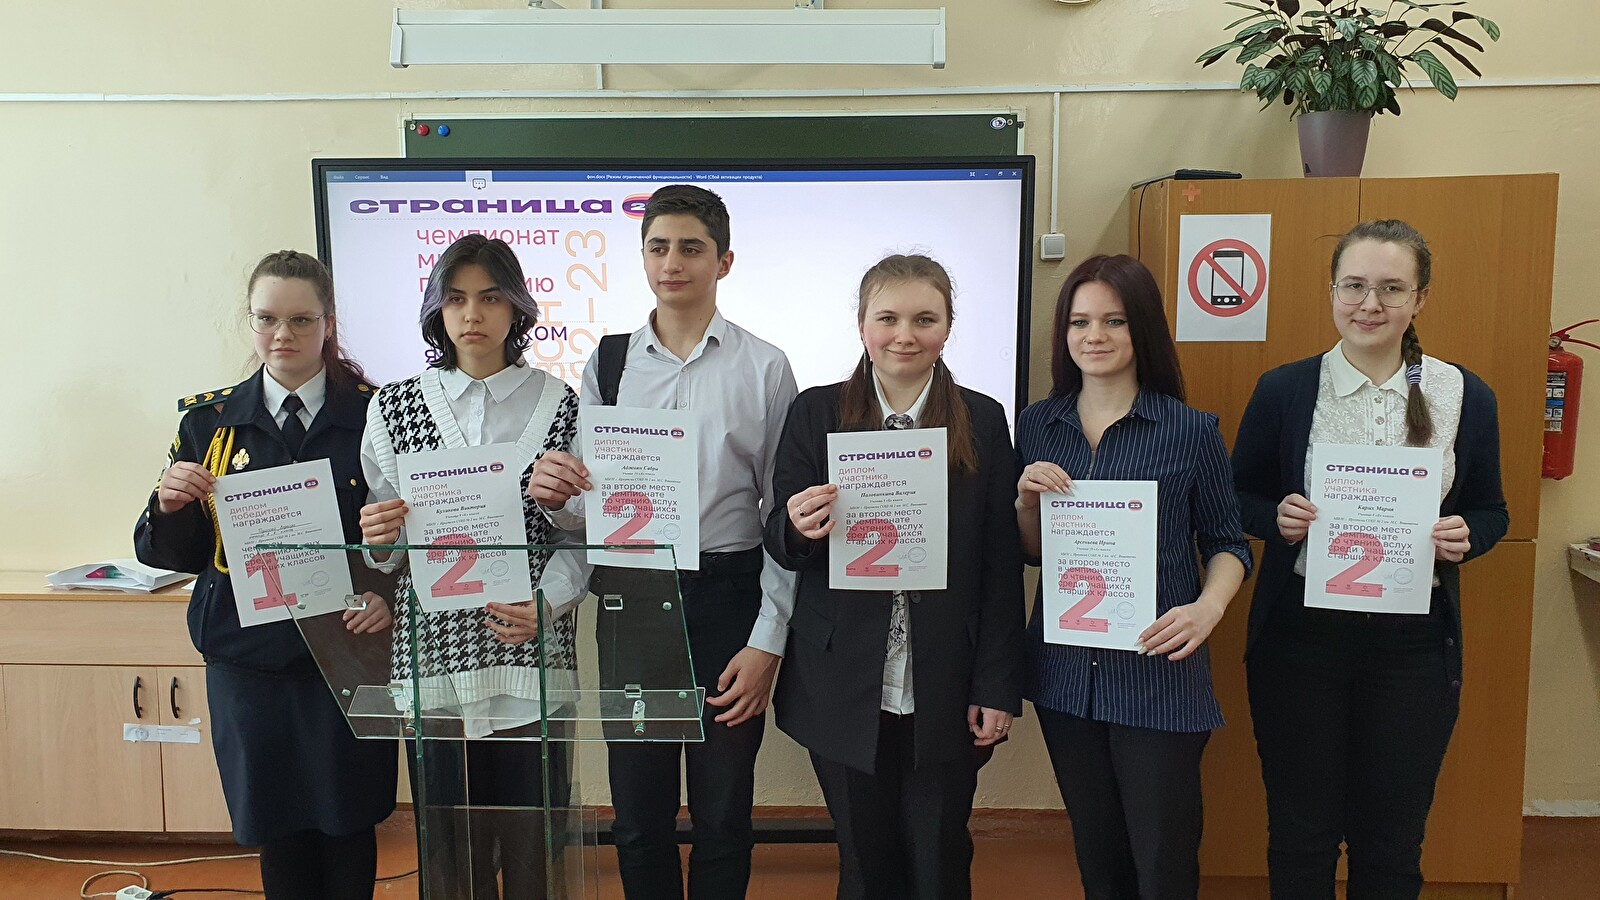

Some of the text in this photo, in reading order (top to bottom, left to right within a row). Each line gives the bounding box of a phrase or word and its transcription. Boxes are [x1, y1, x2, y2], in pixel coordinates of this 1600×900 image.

[350, 199, 612, 214] страница
[416, 229, 560, 246] чемионат
[594, 426, 668, 436] страница
[595, 453, 661, 462] награждается
[838, 450, 916, 462] страница
[410, 466, 488, 481] страница
[839, 467, 875, 475] диплом
[1326, 464, 1409, 476] страница
[839, 474, 888, 483] участника
[410, 483, 448, 494] диплом
[839, 480, 906, 490] награждается
[1325, 485, 1377, 494] участника
[224, 482, 302, 502] страница
[412, 488, 462, 501] участника
[1324, 493, 1397, 502] награждается
[413, 493, 481, 508] награждается
[1051, 501, 1125, 509] страница
[230, 502, 267, 516] диплом
[231, 506, 289, 522] победителя
[232, 510, 302, 528] награждается
[603, 491, 655, 554] 2
[436, 525, 469, 534] второе
[472, 521, 499, 530] место
[897, 524, 923, 532] вслух
[1051, 528, 1115, 537] награждается
[1343, 524, 1378, 532] второе
[432, 530, 488, 541] чемпионате
[877, 531, 922, 539] учащихся
[1337, 532, 1398, 540] чемпионате
[846, 519, 899, 576] 2
[1384, 542, 1412, 550] вслух
[471, 550, 507, 559] классов
[1361, 548, 1410, 556] учащихся
[288, 555, 325, 567] классов
[1325, 532, 1383, 598] 2
[1373, 556, 1414, 564] классов
[426, 534, 484, 598] 2
[245, 551, 298, 610] 1
[1059, 567, 1108, 633] 2
